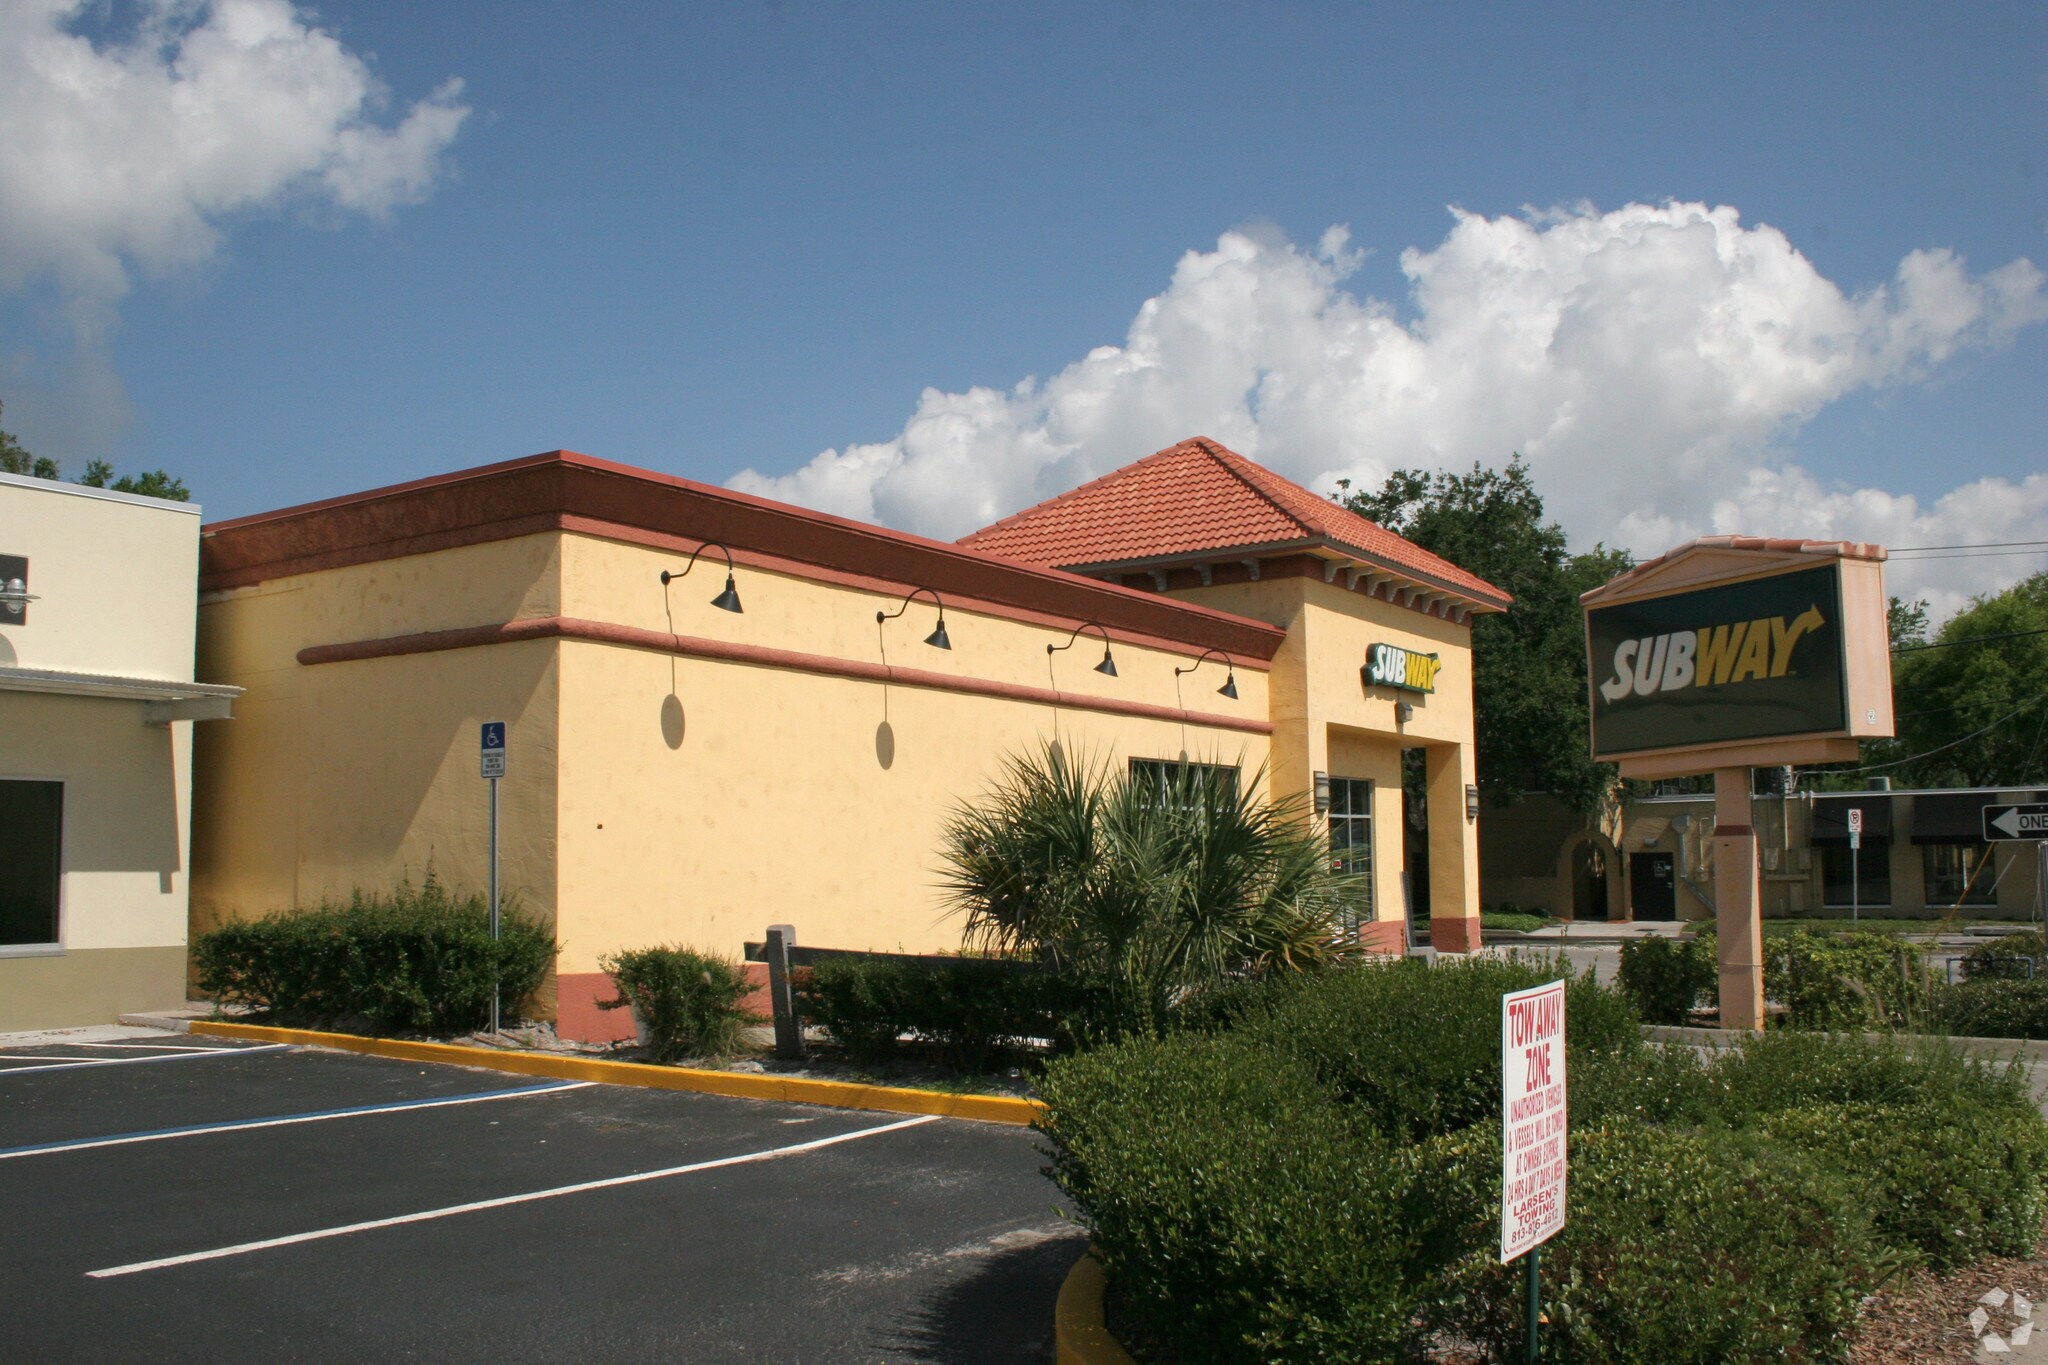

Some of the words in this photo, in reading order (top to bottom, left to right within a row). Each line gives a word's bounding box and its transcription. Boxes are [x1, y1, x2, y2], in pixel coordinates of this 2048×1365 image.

[1373, 645, 1441, 690] SUBWAY
[1600, 603, 1825, 705] SUBWAY
[2019, 815, 2048, 829] ONE
[1509, 1001, 1535, 1048] TOW
[1536, 994, 1560, 1041] AWAY
[1526, 1043, 1551, 1092] ZONE
[1511, 1091, 1544, 1123] UNAUTHORIZED
[1515, 1123, 1534, 1150] VESSELS
[1516, 1153, 1522, 1176] AT
[1508, 1182, 1513, 1205] 24
[1514, 1178, 1524, 1202] HRS
[1513, 1184, 1559, 1217] LARSEN'S
[1511, 1208, 1558, 1244] 813-876-4612
[1518, 1198, 1555, 1227] TOWING
